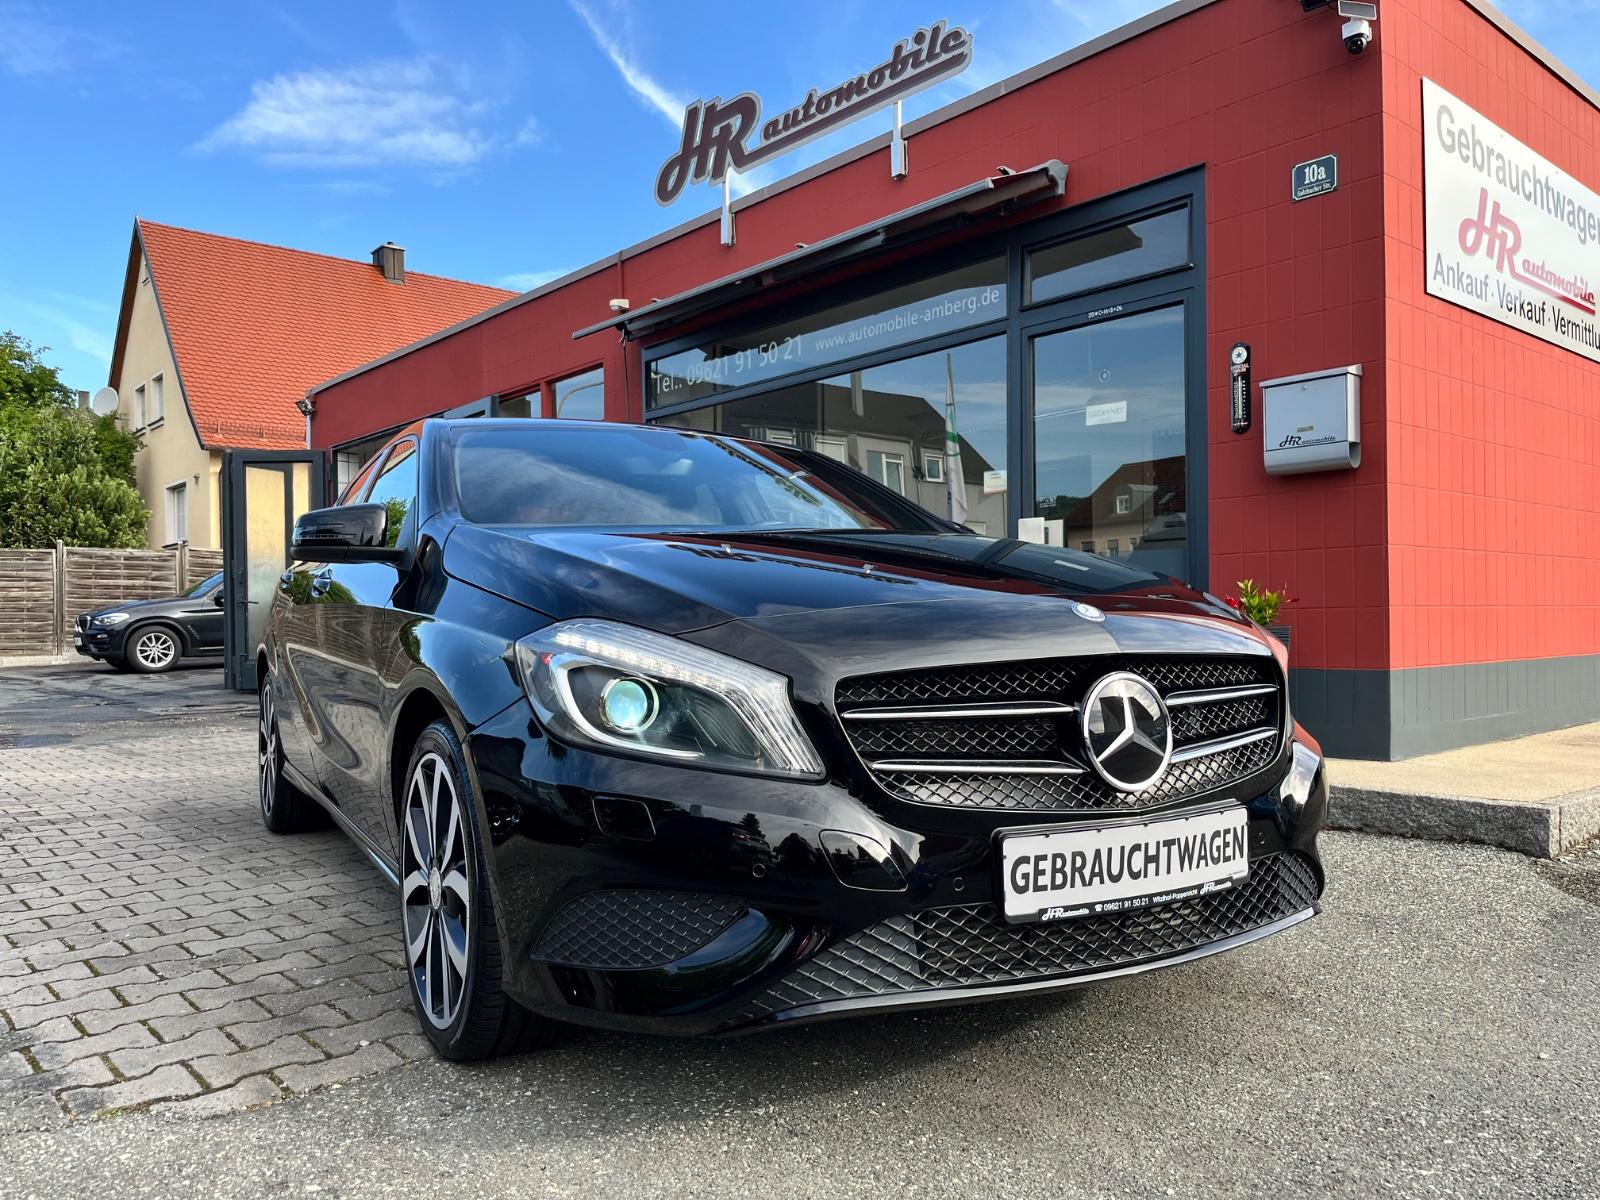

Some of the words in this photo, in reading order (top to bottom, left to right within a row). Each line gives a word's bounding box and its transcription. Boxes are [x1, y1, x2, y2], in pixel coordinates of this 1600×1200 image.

[655, 94, 761, 204] HR
[762, 22, 970, 142] automobile
[1303, 164, 1327, 185] 10a
[1436, 104, 1600, 246] Gebrauchtwage
[1433, 252, 1489, 303] Ankauf
[1496, 279, 1546, 327] Verkauf
[1458, 186, 1522, 274] HR
[1521, 257, 1597, 306] automobile
[686, 355, 729, 386] 09621
[735, 348, 752, 373] 91
[759, 341, 778, 367] 50
[783, 335, 802, 360] 21
[814, 287, 1000, 351] www.automobile-amberg.de
[1010, 825, 1245, 895] GEBRAUCHTWAGEN
[1124, 900, 1131, 908] 91
[1132, 899, 1140, 907] 50
[1141, 897, 1149, 905] 21
